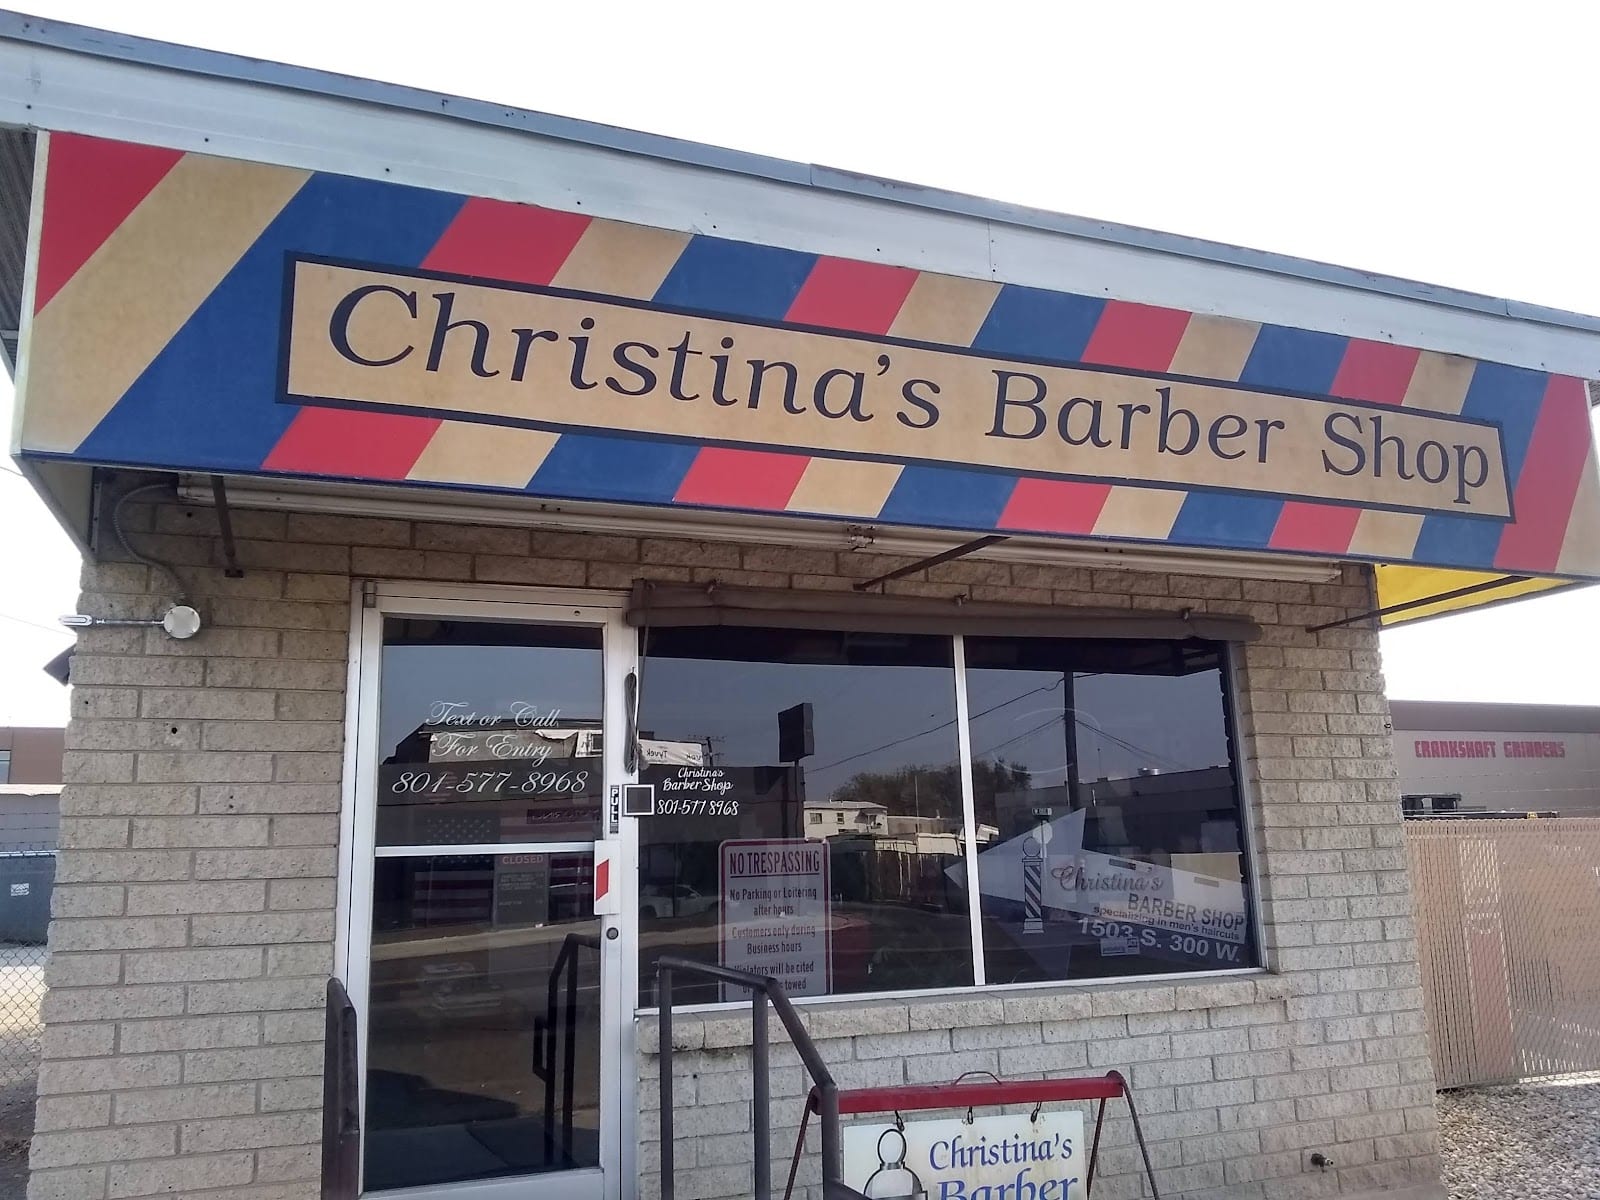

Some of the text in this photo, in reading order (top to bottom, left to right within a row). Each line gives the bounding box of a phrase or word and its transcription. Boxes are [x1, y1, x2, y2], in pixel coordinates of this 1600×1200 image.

[328, 284, 1490, 504] Christina's Barber Shop
[425, 700, 560, 727] Text or Call
[431, 731, 553, 768] For Entry
[1414, 740, 1566, 758] CRANKSHAFT GRINDERS
[391, 770, 589, 794] 801-577-8968
[662, 778, 734, 795] Barber Shop
[610, 788, 619, 823] PULL
[708, 799, 739, 816] 8968
[502, 855, 544, 865] CLOSED
[730, 850, 820, 875] NO TRESPASSING
[1051, 864, 1163, 892] Christina's
[729, 887, 817, 902] No Parking or Loitering
[753, 903, 794, 916] after hours
[1128, 892, 1245, 931] BARBER SHOP
[732, 924, 816, 938] Customers only during
[1093, 905, 1240, 941] specializing in men's haircuts
[747, 941, 802, 954] Business hours
[1078, 916, 1134, 938] 1503
[1140, 928, 1162, 949] S.
[1169, 934, 1209, 957] 300
[1215, 942, 1240, 963] W.
[769, 962, 784, 975] will
[785, 962, 795, 974] be
[796, 960, 814, 973] cited
[785, 978, 807, 991] towed
[929, 1132, 1073, 1171] Christina's
[937, 1167, 1079, 1200] Barber
